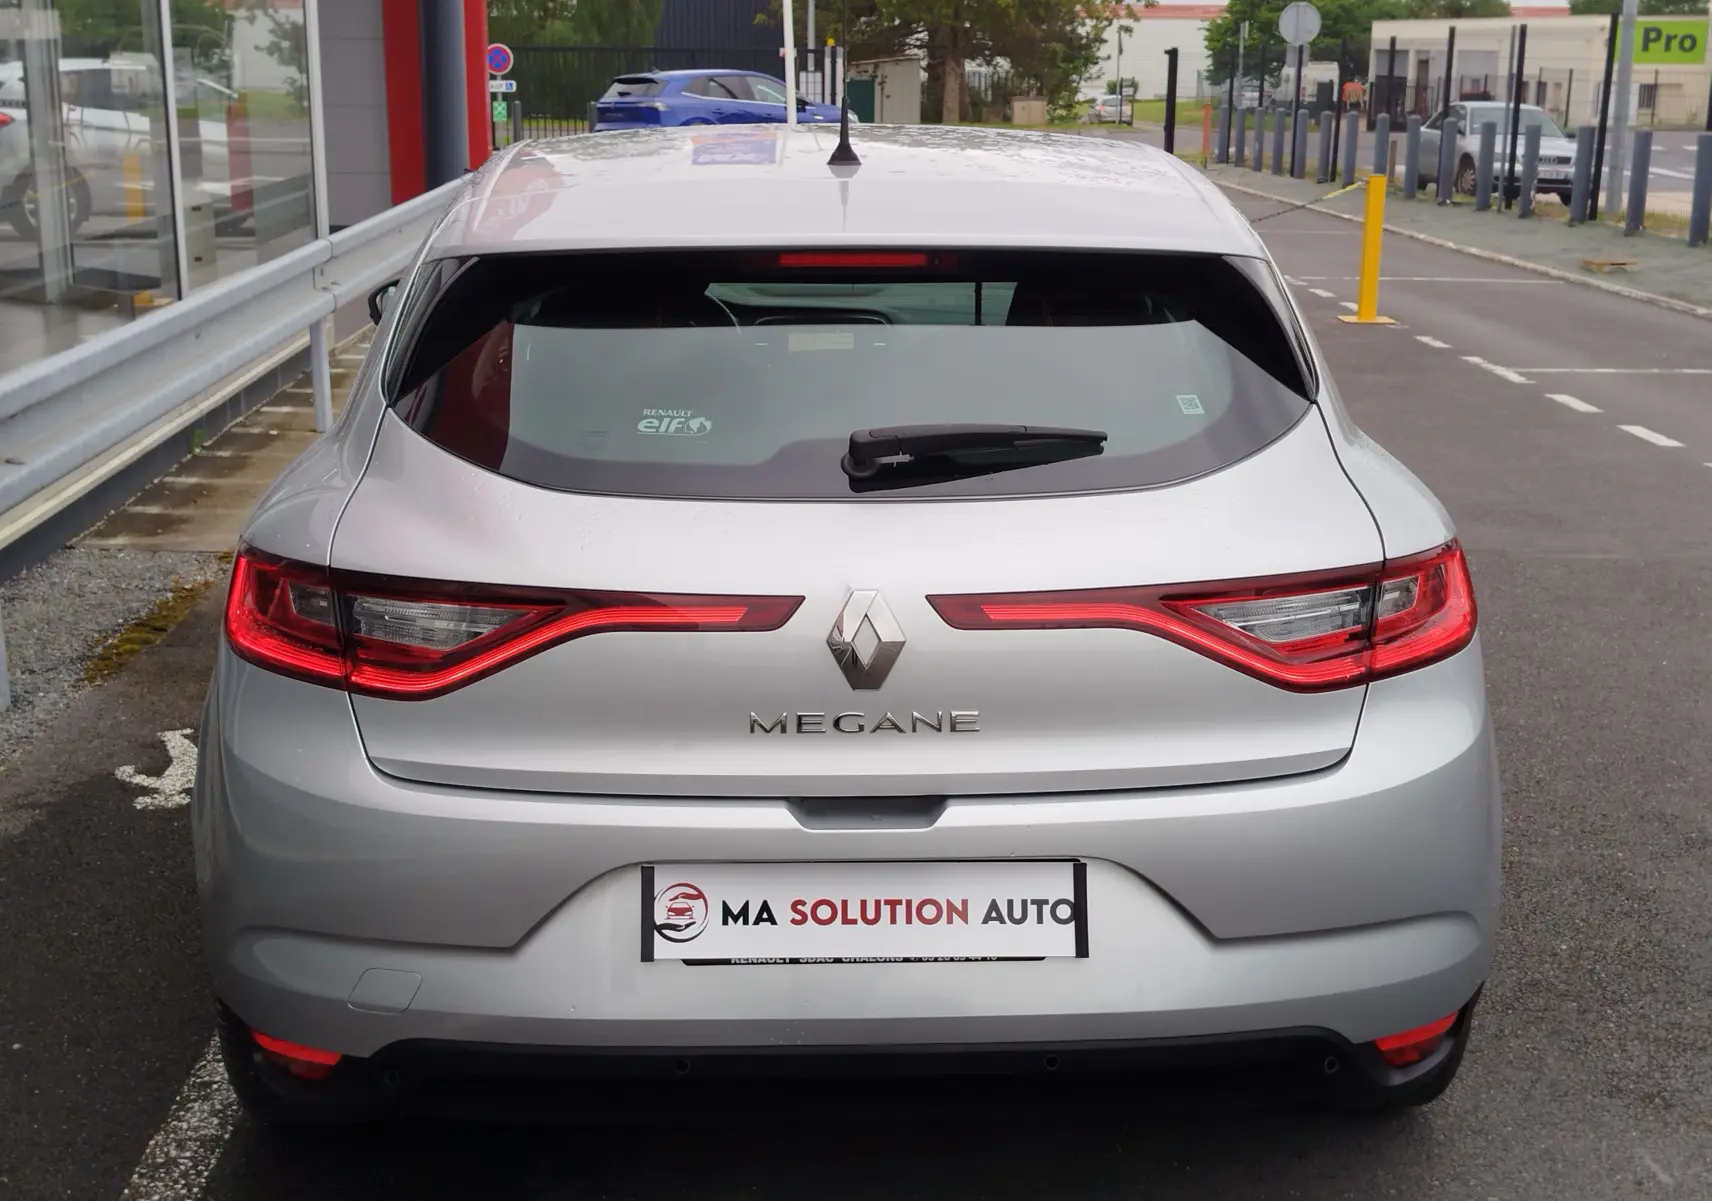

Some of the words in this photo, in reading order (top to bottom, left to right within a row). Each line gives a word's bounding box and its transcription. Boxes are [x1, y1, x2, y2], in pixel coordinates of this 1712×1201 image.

[1640, 26, 1698, 53] Pro
[642, 408, 694, 417] RENAULT
[637, 417, 686, 433] elf
[750, 710, 981, 734] MEGANE
